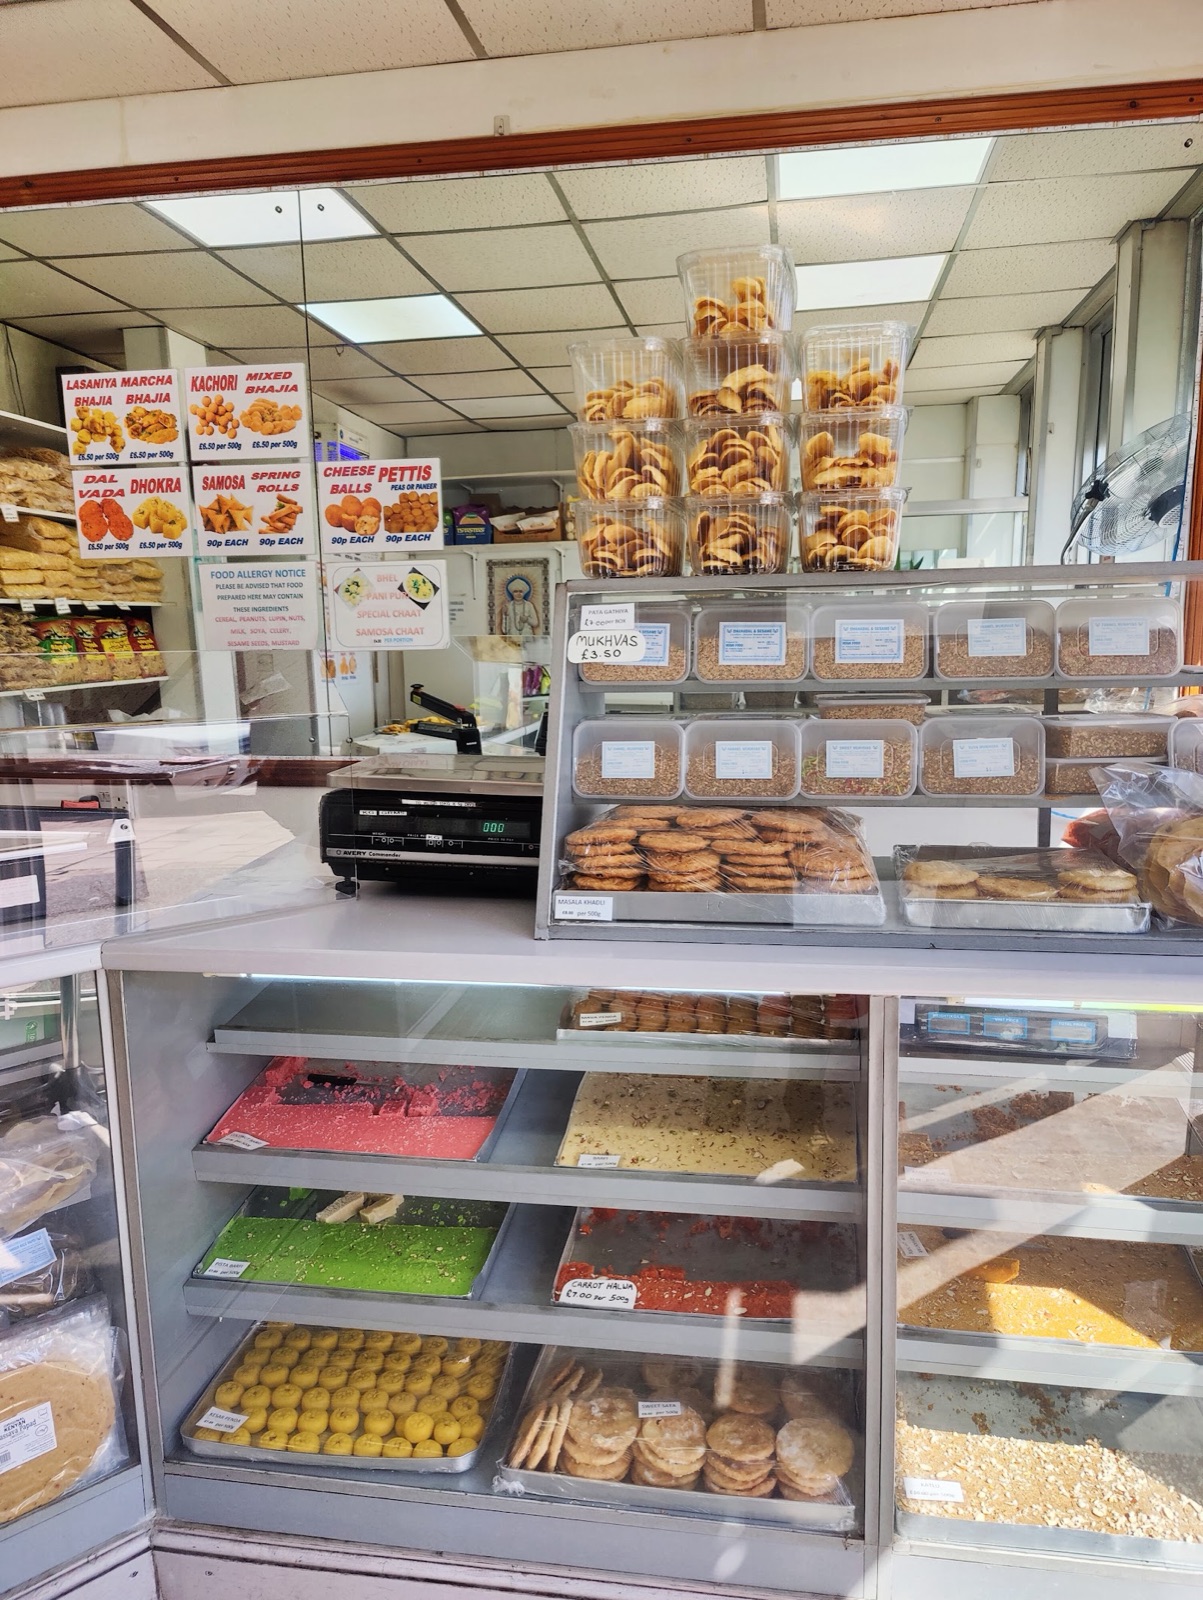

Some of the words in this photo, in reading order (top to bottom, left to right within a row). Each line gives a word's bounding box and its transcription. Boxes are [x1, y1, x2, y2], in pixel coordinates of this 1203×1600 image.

[120, 375, 172, 387] MARCHA
[246, 372, 292, 380] MIXED
[66, 379, 118, 390] LASANIYA
[191, 374, 238, 392] KACHORI
[244, 384, 298, 394] BHAJIA
[74, 396, 112, 406] BHAJIA
[125, 392, 171, 404] BHAJIA
[199, 442, 215, 450] £6.50
[228, 442, 242, 451] 500g
[270, 442, 281, 450] per
[282, 440, 298, 450] 500g
[105, 452, 120, 462] 500g
[148, 452, 158, 460] per
[159, 450, 174, 459] 500g
[250, 471, 301, 480] SPRING
[323, 466, 376, 477] CHEESE
[378, 465, 432, 482] PETTIS
[83, 475, 118, 484] DAL
[202, 475, 245, 491] SAMOSA
[130, 478, 182, 494] DHOKRA
[256, 484, 299, 493] ROLLS
[330, 483, 372, 494] BALLS
[78, 488, 125, 498] VADA
[207, 539, 222, 548] 90p
[224, 538, 248, 546] EACH
[259, 538, 276, 546] 90p
[278, 537, 304, 545] EACH
[331, 537, 347, 545] 90p
[349, 536, 375, 544] EACH
[386, 536, 402, 544] 90p
[116, 542, 129, 551] 500g
[157, 542, 167, 550] per
[168, 541, 182, 550] 500g
[210, 571, 235, 579] FOOD
[237, 570, 273, 578] ALLERGY
[275, 569, 306, 577] NOTICE
[376, 574, 398, 582] BHEL
[366, 592, 388, 600] PANI
[357, 610, 390, 618] SPECIAL
[392, 610, 422, 618] CHAAT
[356, 628, 394, 636] SAMOSA
[576, 634, 638, 647] MUKHVAS
[581, 649, 621, 659] £3.50
[483, 822, 504, 832] 000
[572, 1281, 604, 1289] CARROT
[606, 1282, 634, 1290] HALWA
[566, 1290, 592, 1299] £7.00
[609, 1294, 629, 1303] 500g
[0, 1429, 18, 1440] assava
[19, 1419, 36, 1431] Papad
[4, 1420, 26, 1432] KENYAN
